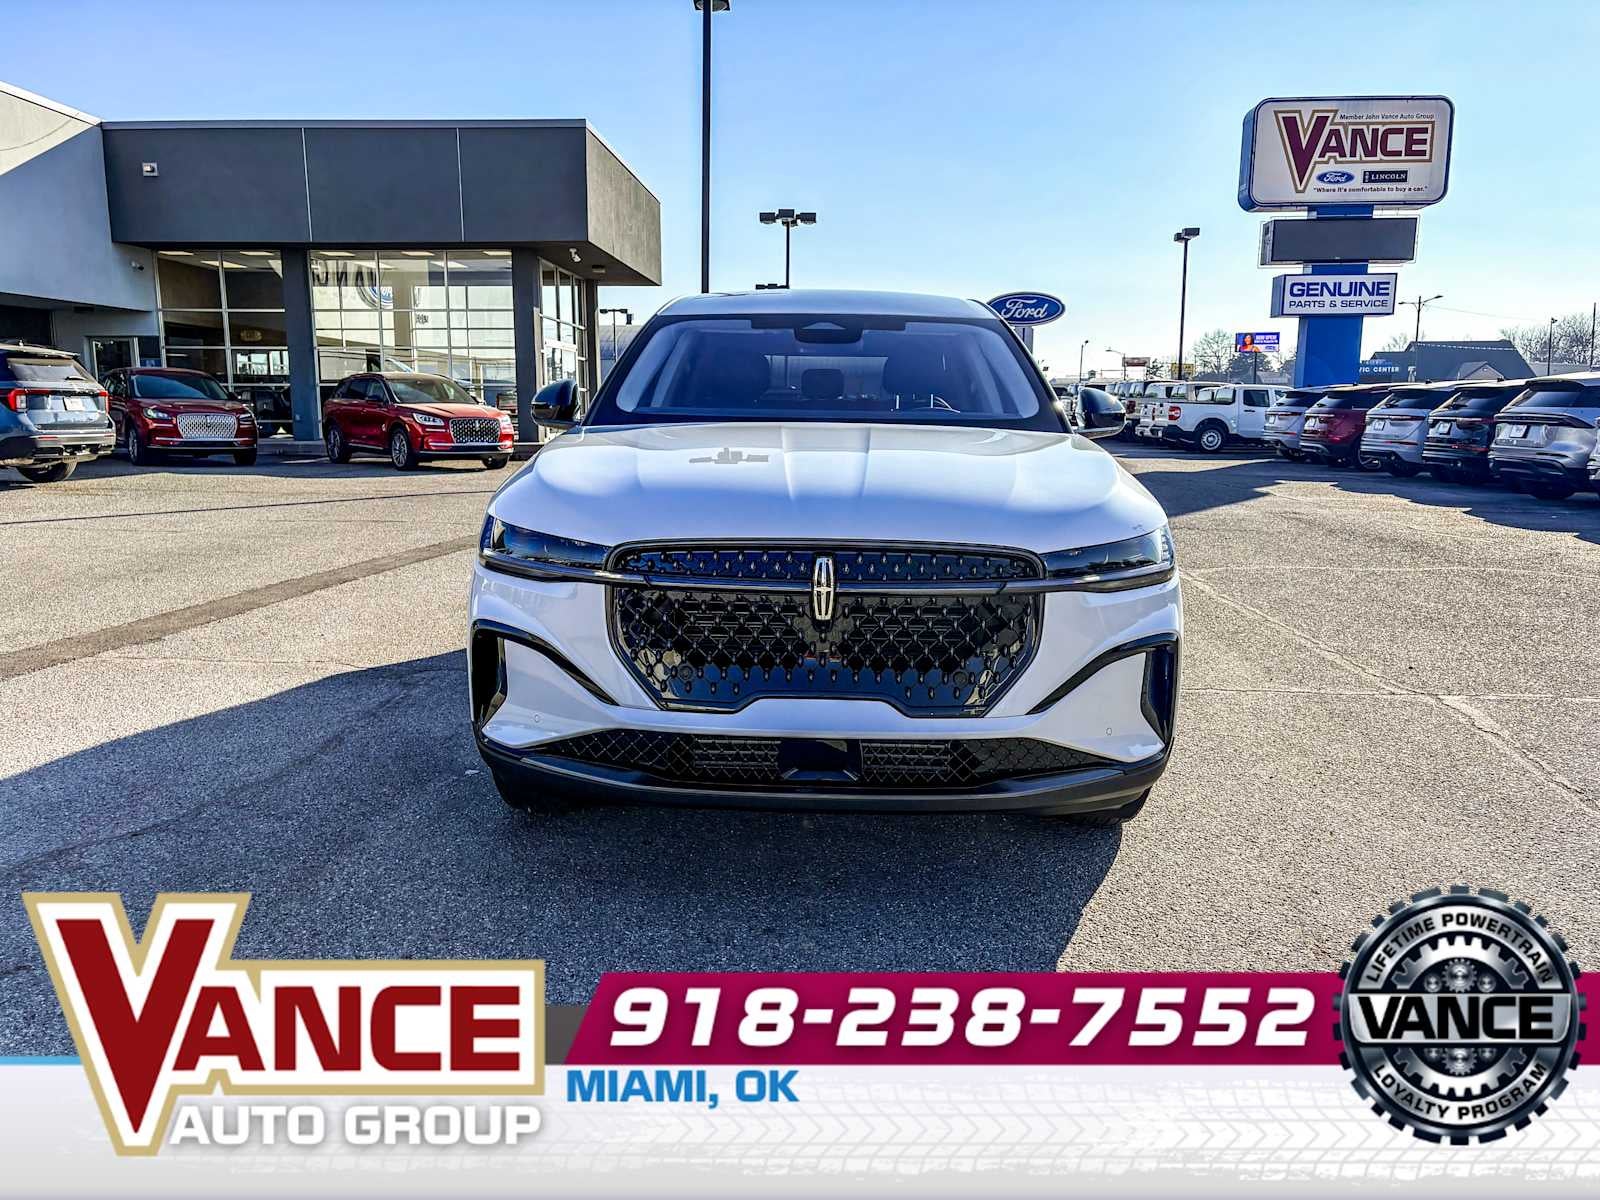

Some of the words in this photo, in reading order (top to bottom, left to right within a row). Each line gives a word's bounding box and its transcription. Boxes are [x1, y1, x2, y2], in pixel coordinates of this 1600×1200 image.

[1416, 113, 1434, 121] Group
[1280, 114, 1430, 189] VANCE
[1323, 172, 1347, 182] Ford
[1289, 281, 1391, 298] GENUINE
[1001, 298, 1048, 318] Ford
[1289, 300, 1326, 309] PARTS
[1329, 300, 1338, 308] &
[1340, 299, 1389, 308] SERVICE
